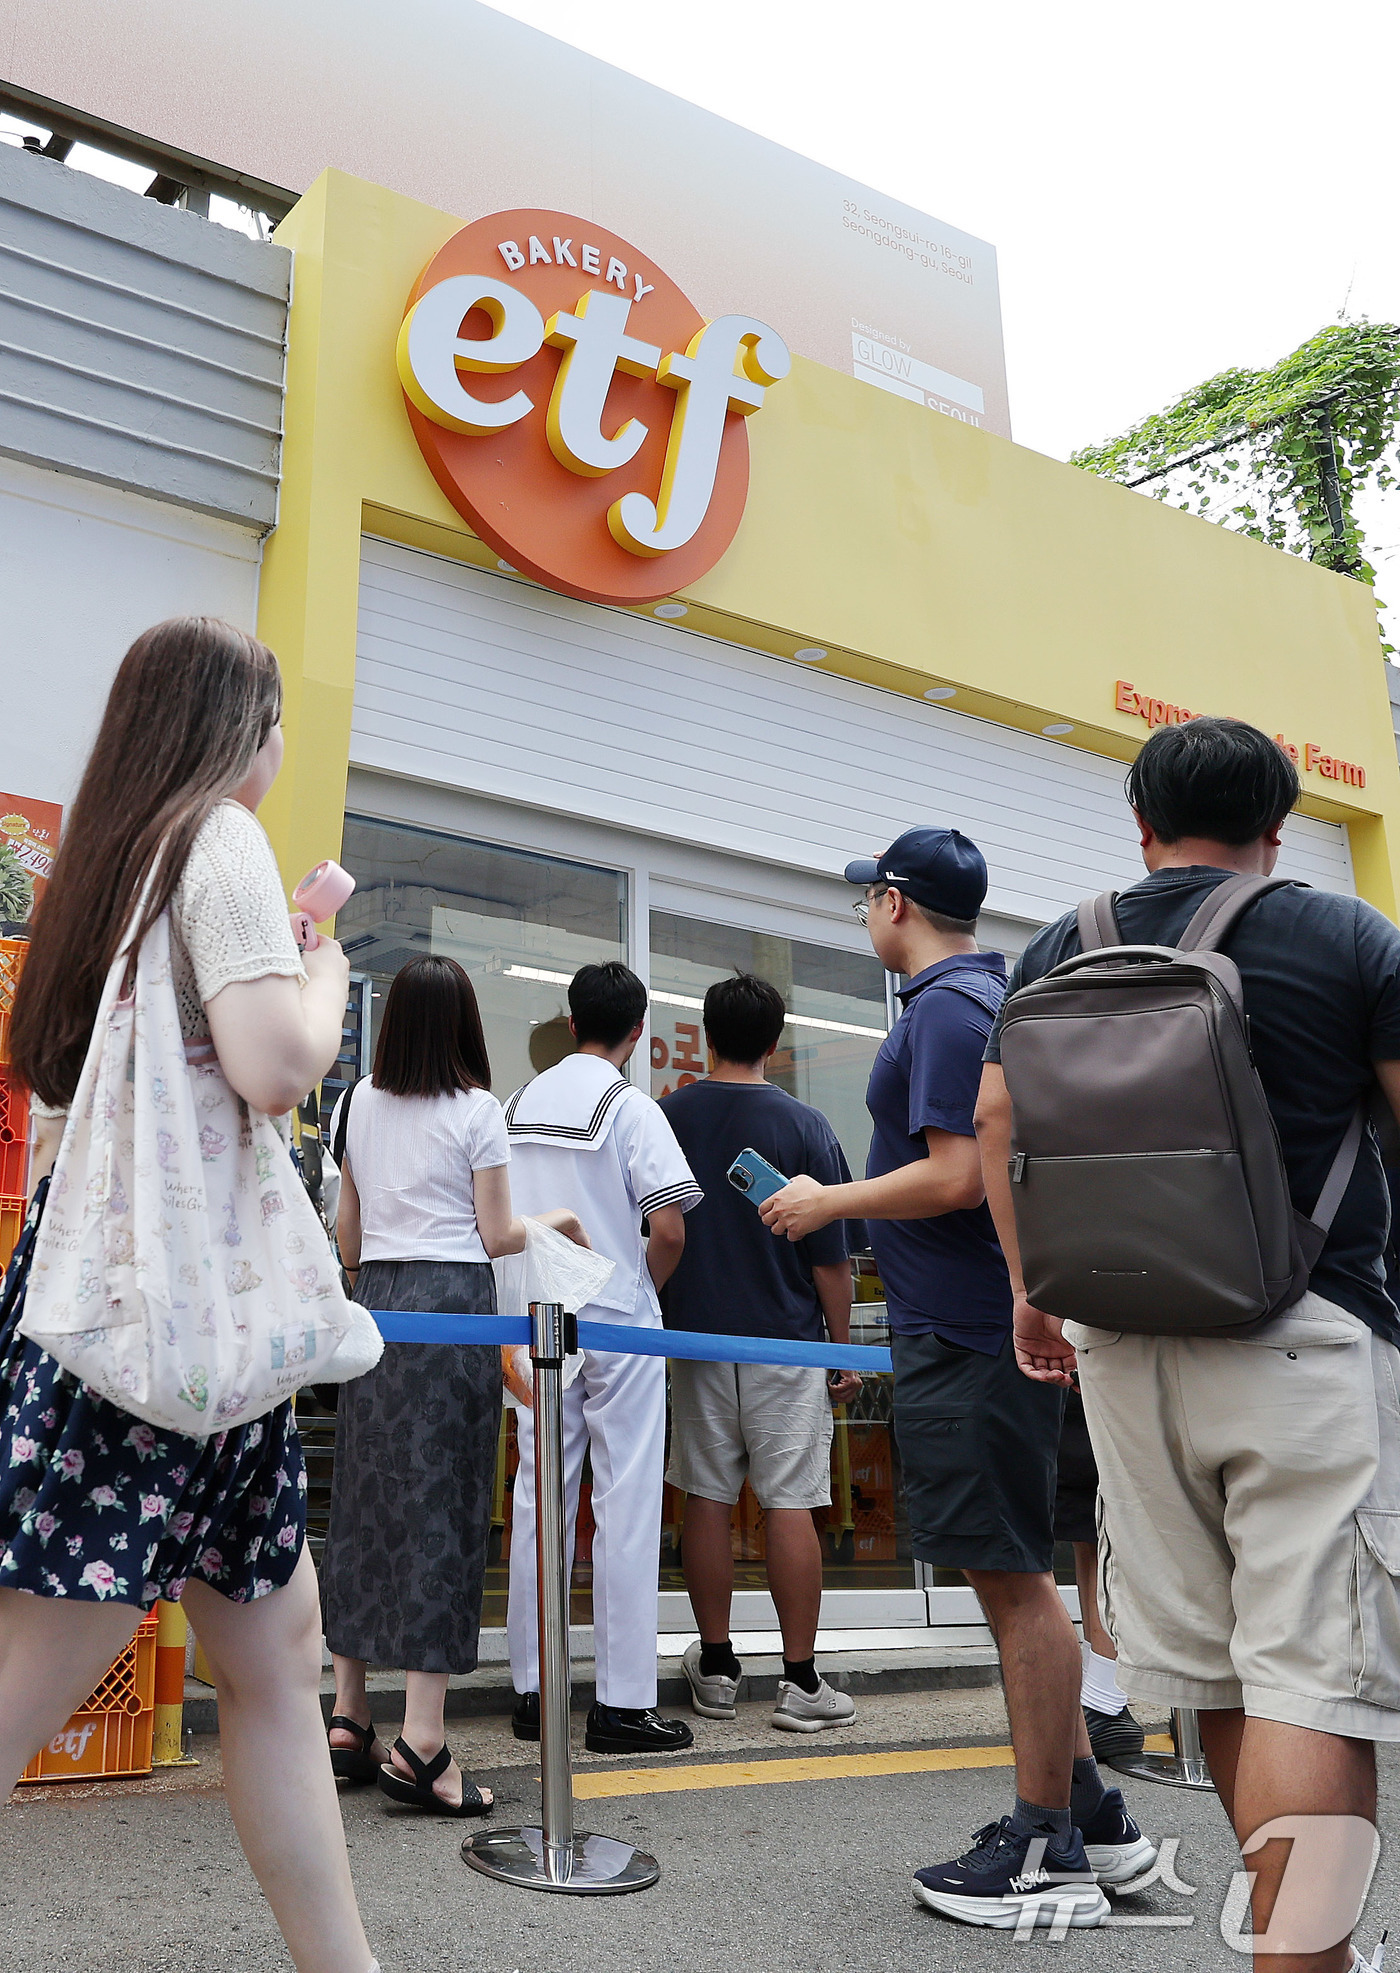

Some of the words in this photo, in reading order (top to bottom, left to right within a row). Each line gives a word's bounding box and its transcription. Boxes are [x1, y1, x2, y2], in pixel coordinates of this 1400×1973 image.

[842, 215, 939, 271] Seongdong-gu,
[941, 262, 974, 286] Seoul
[843, 199, 861, 218] 32,
[863, 209, 938, 253] Seongsui-ro
[940, 244, 972, 270] 16-gil
[497, 235, 655, 303] BAKERY
[851, 317, 897, 345] Designed
[899, 338, 911, 353] by
[858, 340, 912, 378] GLOW
[397, 274, 792, 557] etf
[1305, 743, 1366, 789] Farm
[48, 1722, 97, 1761] etf
[1009, 1867, 1051, 1893] HOKA
